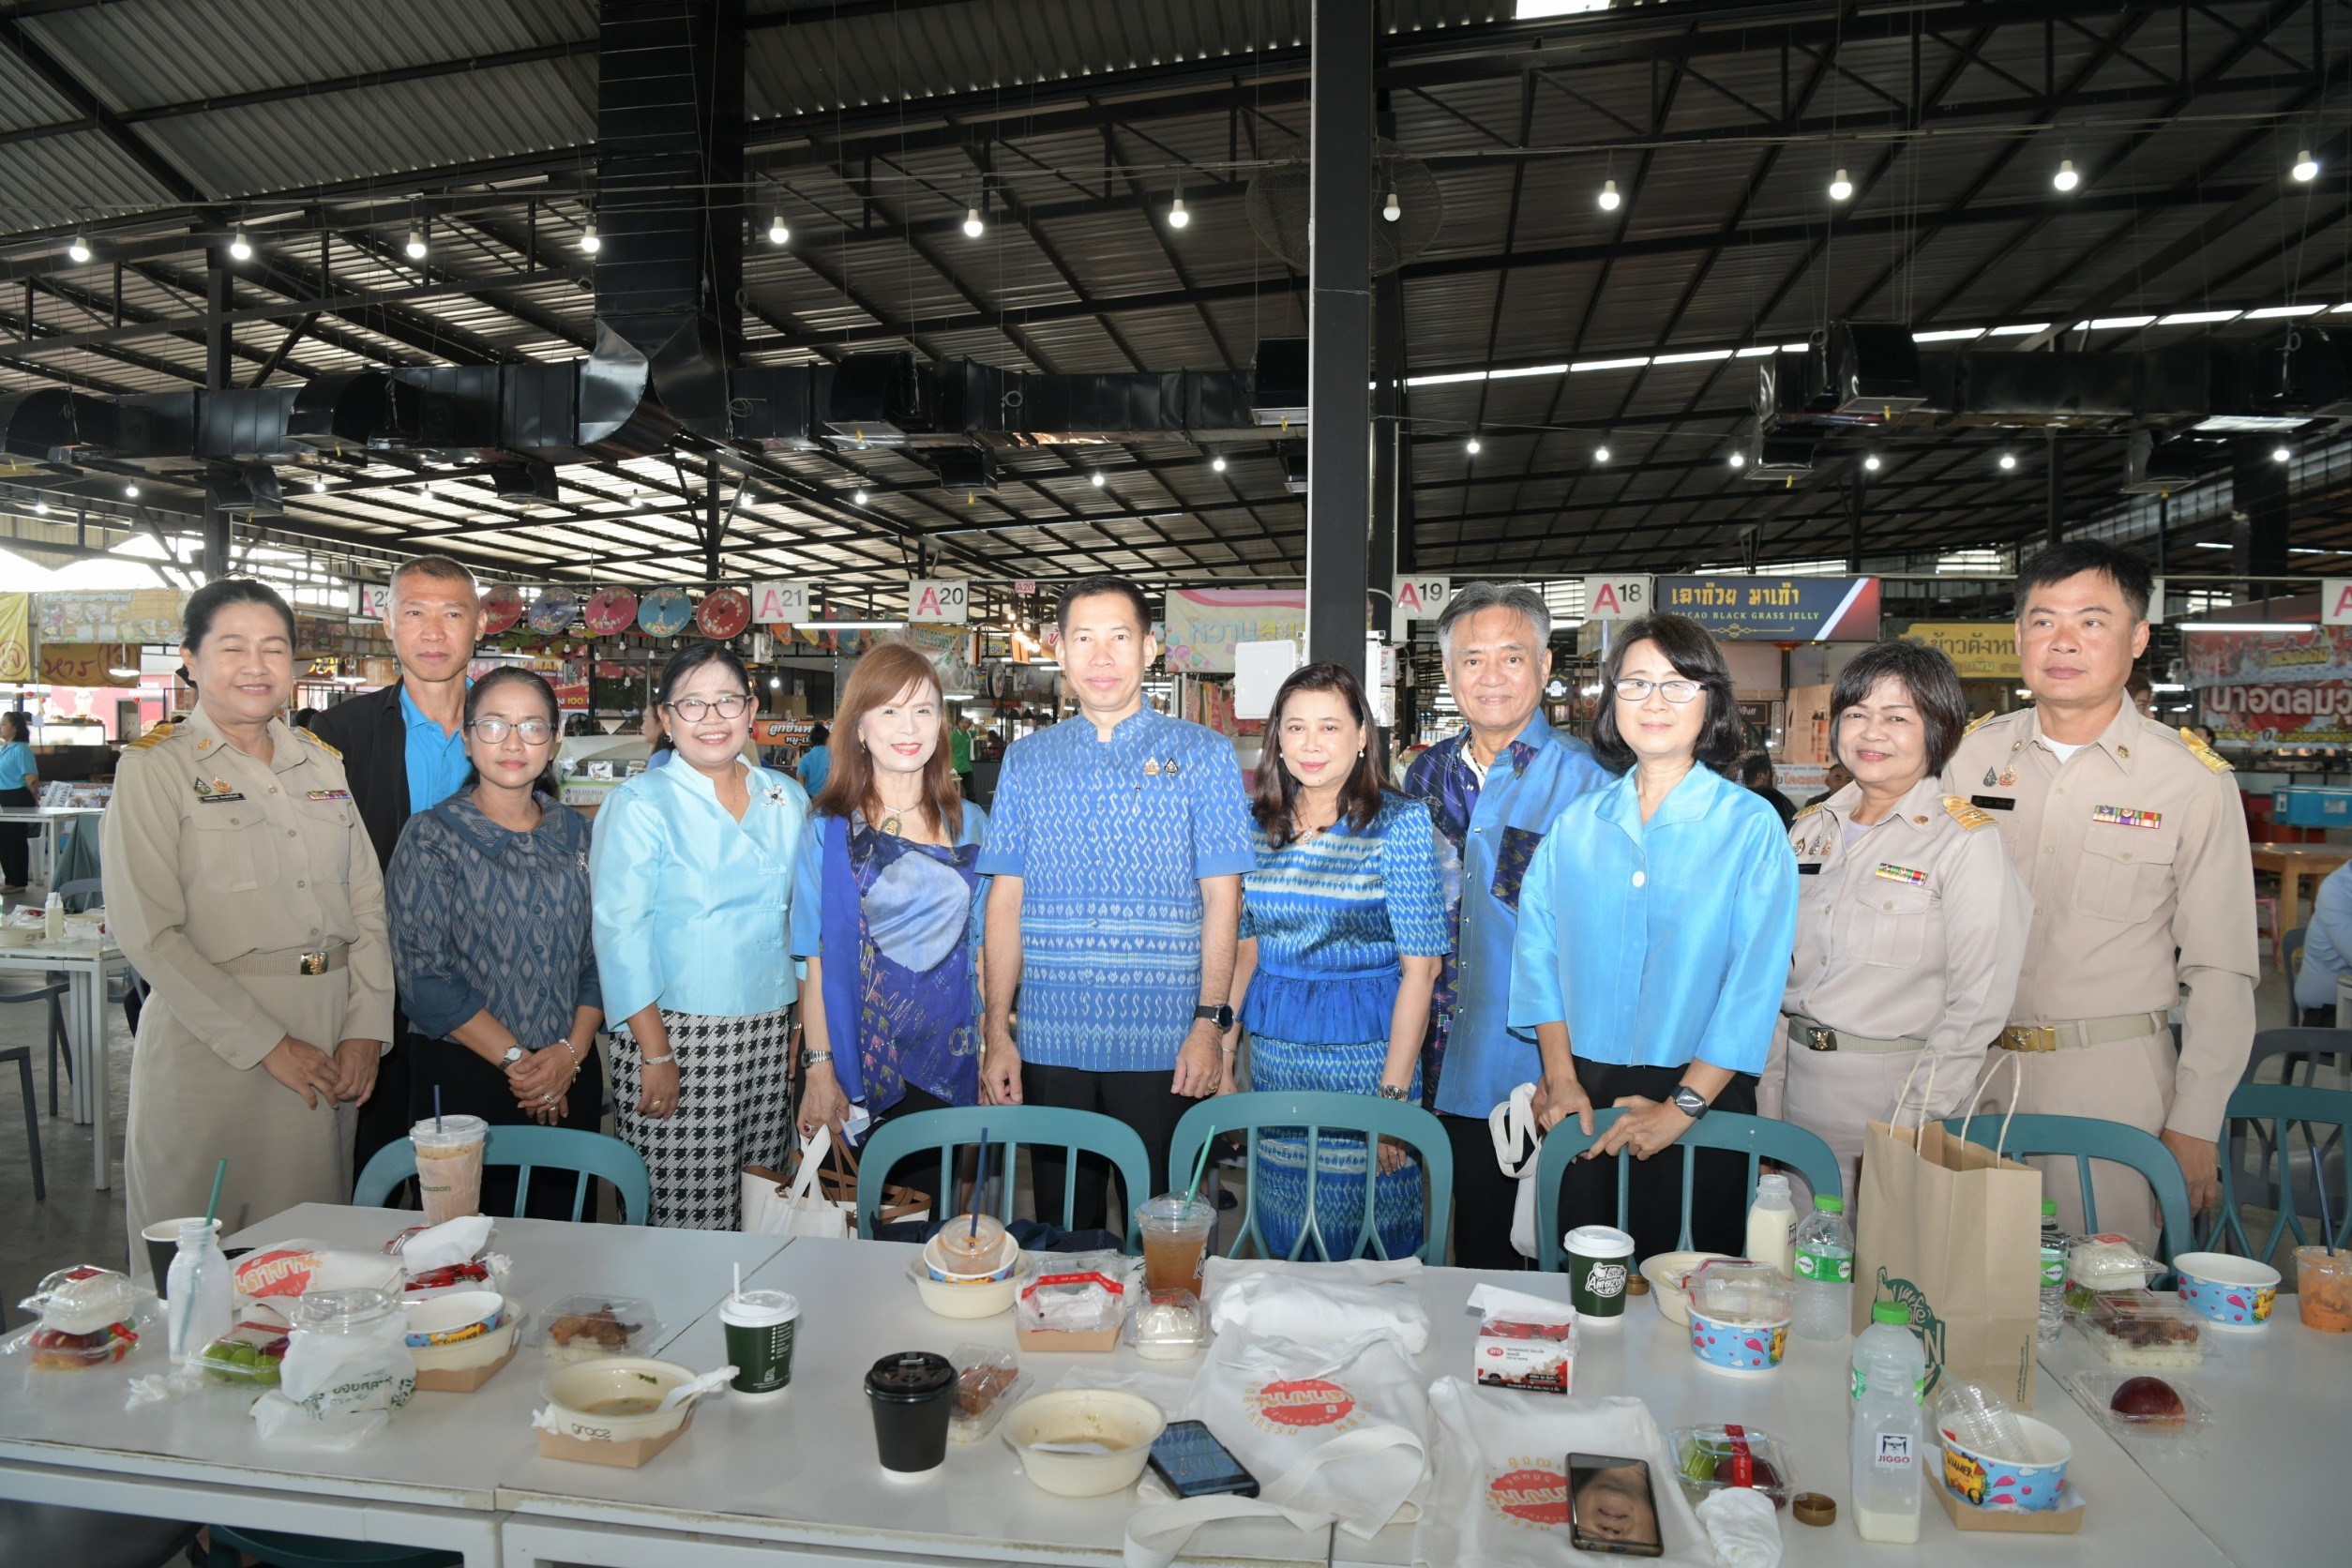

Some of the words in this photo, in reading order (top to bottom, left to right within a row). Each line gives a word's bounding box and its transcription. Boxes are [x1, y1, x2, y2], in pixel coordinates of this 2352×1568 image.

[916, 586, 964, 616] A20
[1017, 582, 1034, 592] A20
[1397, 582, 1443, 613] A19
[1591, 581, 1643, 614] A18
[759, 589, 804, 618] A21
[1671, 611, 1708, 620] MACAO
[1712, 611, 1746, 620] BLACK
[1752, 611, 1785, 620] GRASS
[1789, 611, 1819, 621] JELLY
[1877, 1455, 1910, 1464] JIGGO
